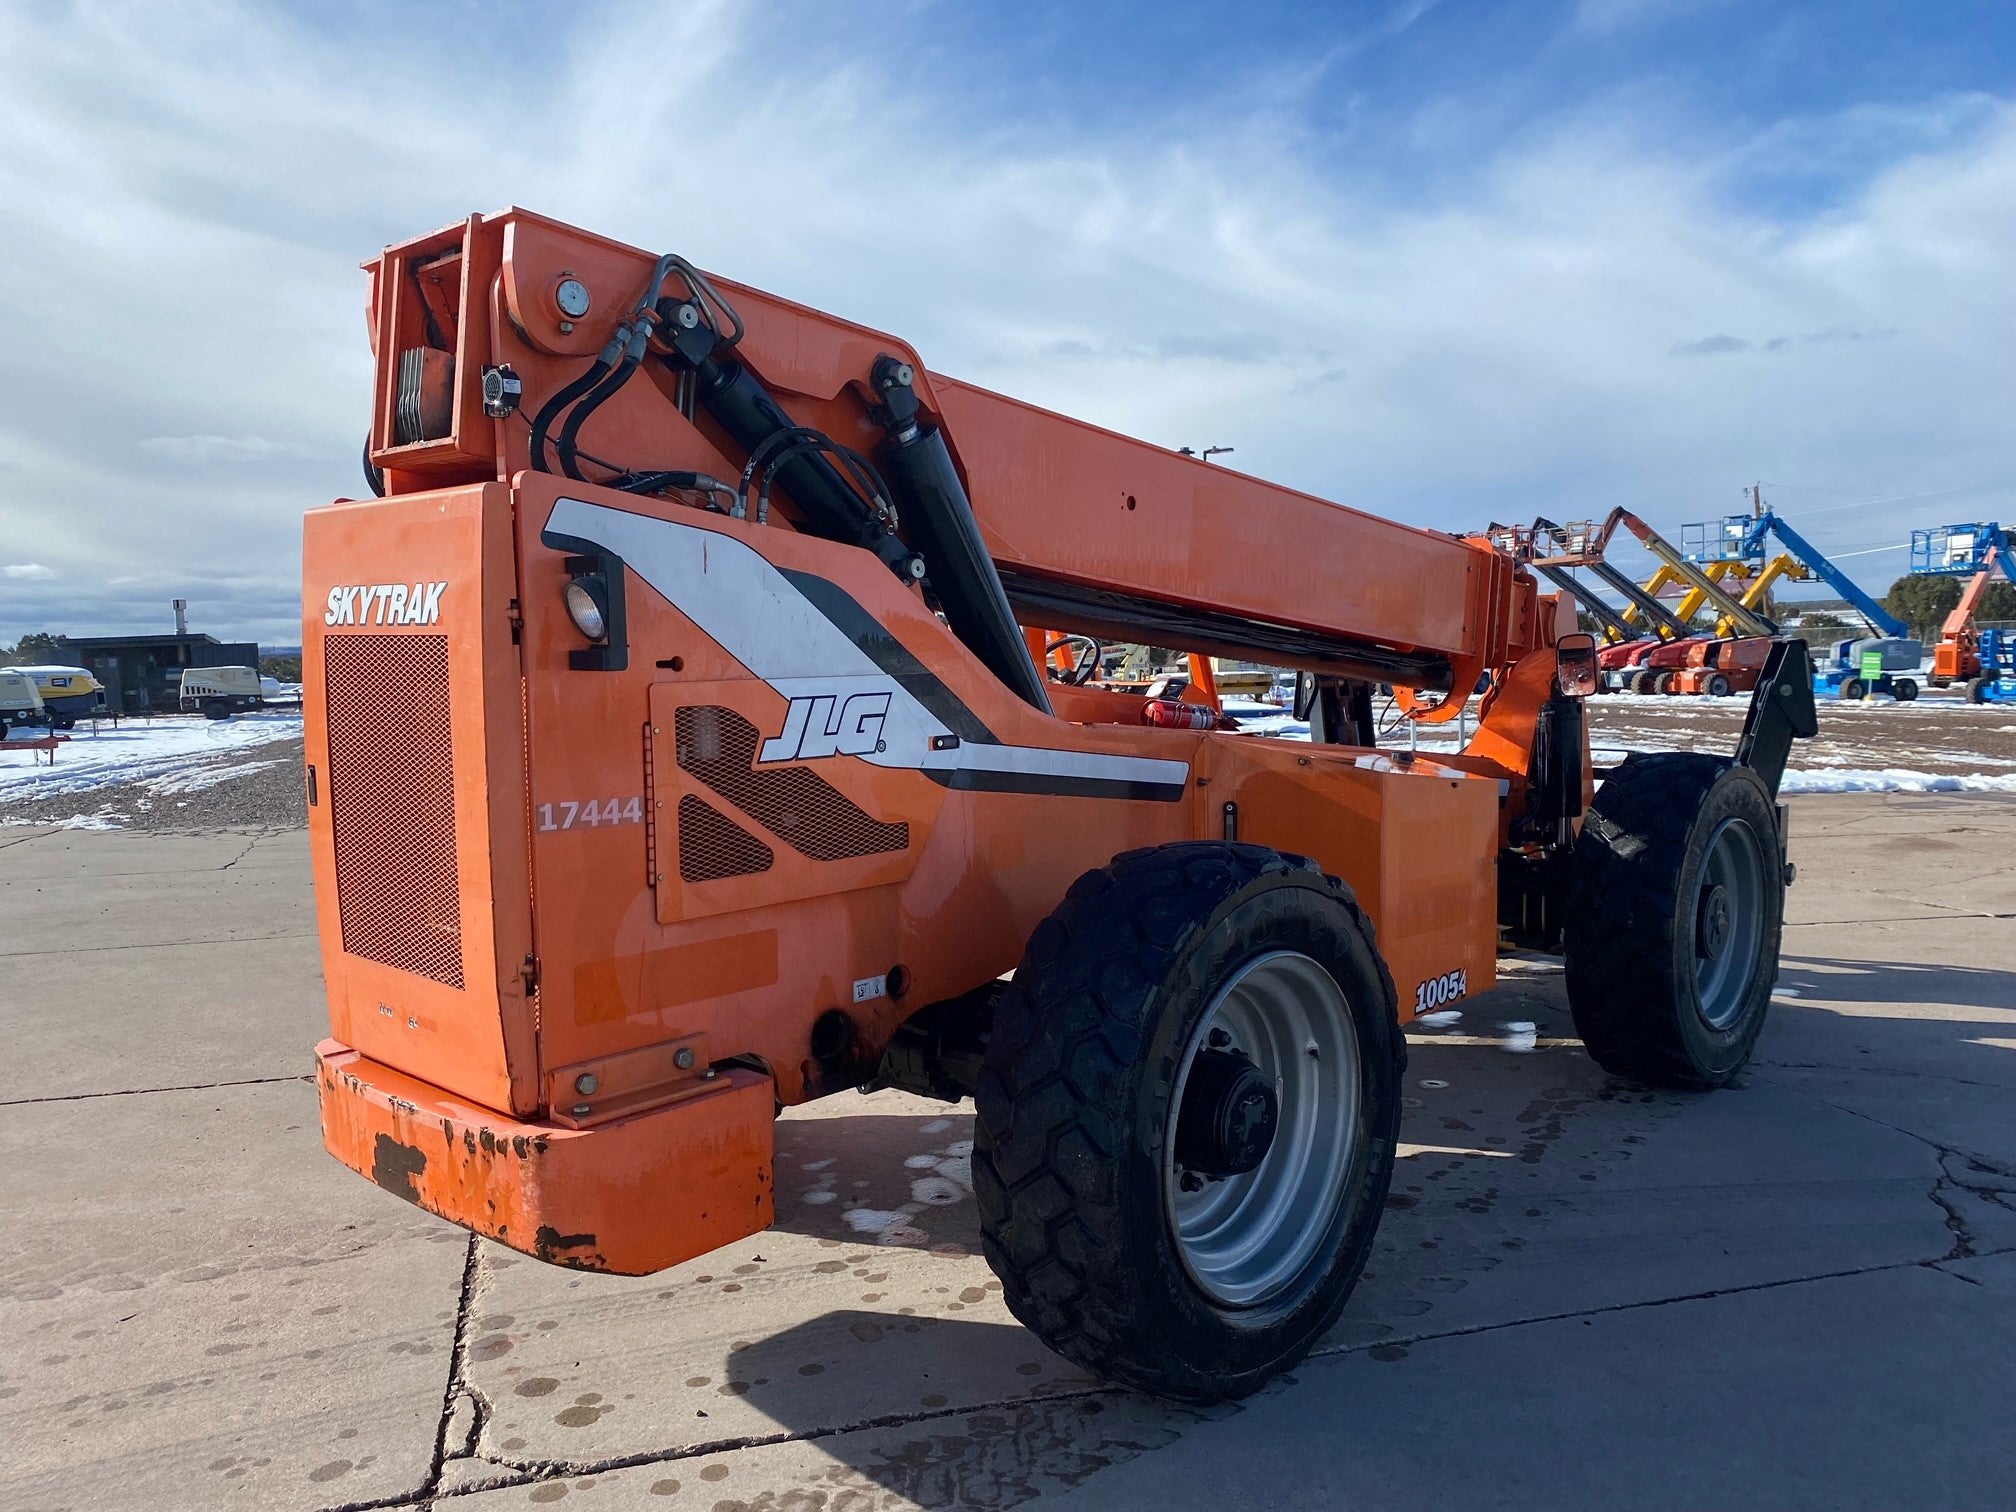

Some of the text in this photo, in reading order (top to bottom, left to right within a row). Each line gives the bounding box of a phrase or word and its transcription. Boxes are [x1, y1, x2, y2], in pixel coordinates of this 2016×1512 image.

[324, 581, 448, 627] SKYTRAK
[757, 692, 892, 764] JLG
[539, 796, 643, 831] 17444
[1414, 968, 1467, 1015] 10054
